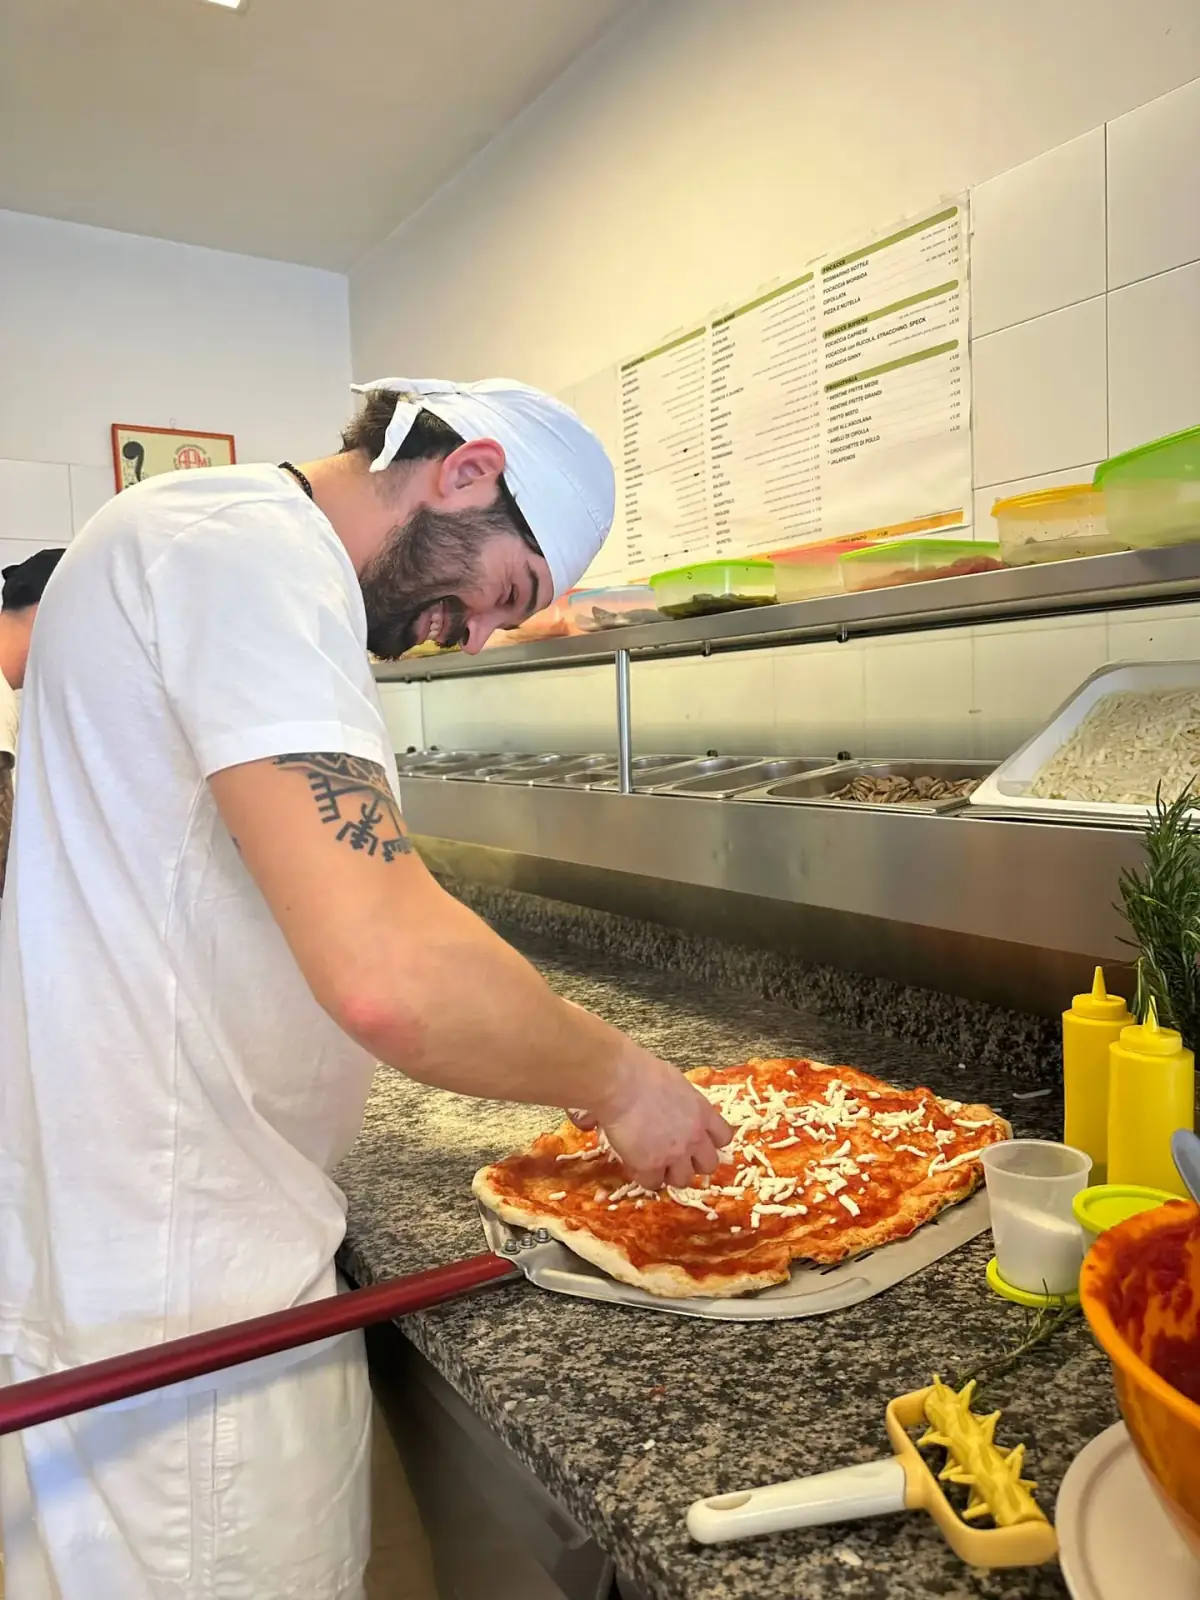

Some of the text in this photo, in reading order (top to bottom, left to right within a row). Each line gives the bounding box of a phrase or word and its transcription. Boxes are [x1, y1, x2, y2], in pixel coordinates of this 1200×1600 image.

[823, 260, 869, 284] ROSMARINO SOTTILE
[823, 271, 867, 295] FOCACCIA MORBIDA
[823, 292, 846, 305] CIPOLLATA
[823, 307, 836, 315] PIZZA
[840, 296, 861, 308] NUTELLA
[825, 327, 868, 348] FOCACCIA CAPRESE
[825, 347, 846, 359] FOCACCIA
[909, 317, 926, 327] SPECK
[825, 357, 846, 369] FOCACCIA
[848, 385, 863, 394] FRITTE
[864, 380, 879, 388] MEDIE
[848, 396, 864, 404] FRITTE
[864, 390, 882, 400] GRANDI
[845, 408, 859, 417] MISTO
[850, 428, 869, 437] CIPOLLA
[830, 441, 859, 454] CROCCHETTE
[865, 435, 880, 444] POLLO
